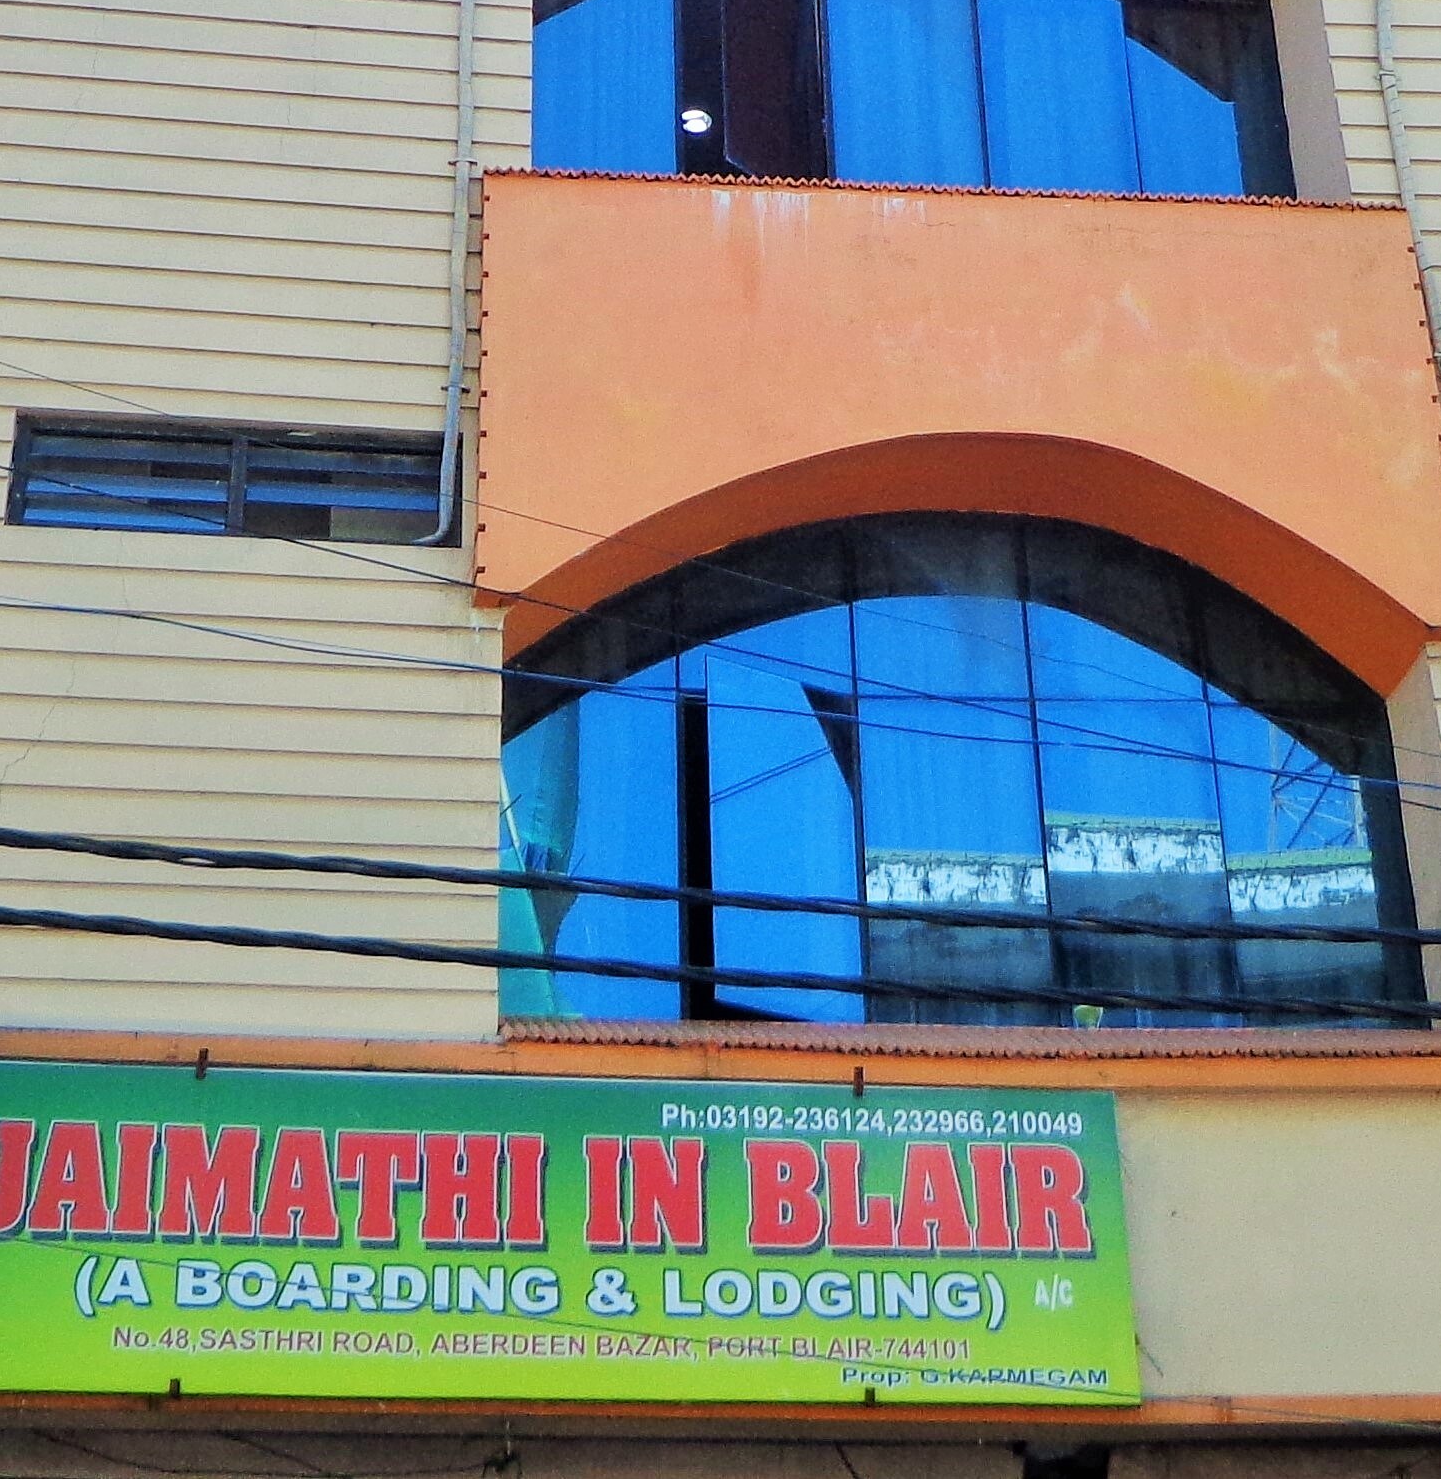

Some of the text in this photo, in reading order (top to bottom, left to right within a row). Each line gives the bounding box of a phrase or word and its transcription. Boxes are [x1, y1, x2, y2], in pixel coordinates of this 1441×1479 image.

[662, 1103, 1083, 1136] Ph:03192-236124,232966,210049
[583, 1134, 706, 1252] IN
[744, 1137, 1095, 1257] BLAIR
[73, 1254, 1006, 1331] (A BOARDING & LODGING)
[1034, 1273, 1074, 1313] A/C
[331, 1330, 421, 1358] ROAD,
[429, 1333, 587, 1358] ABERDEEN
[595, 1334, 698, 1362] BAZAR,
[707, 1335, 780, 1359] PORT
[841, 1366, 909, 1388] Prop:
